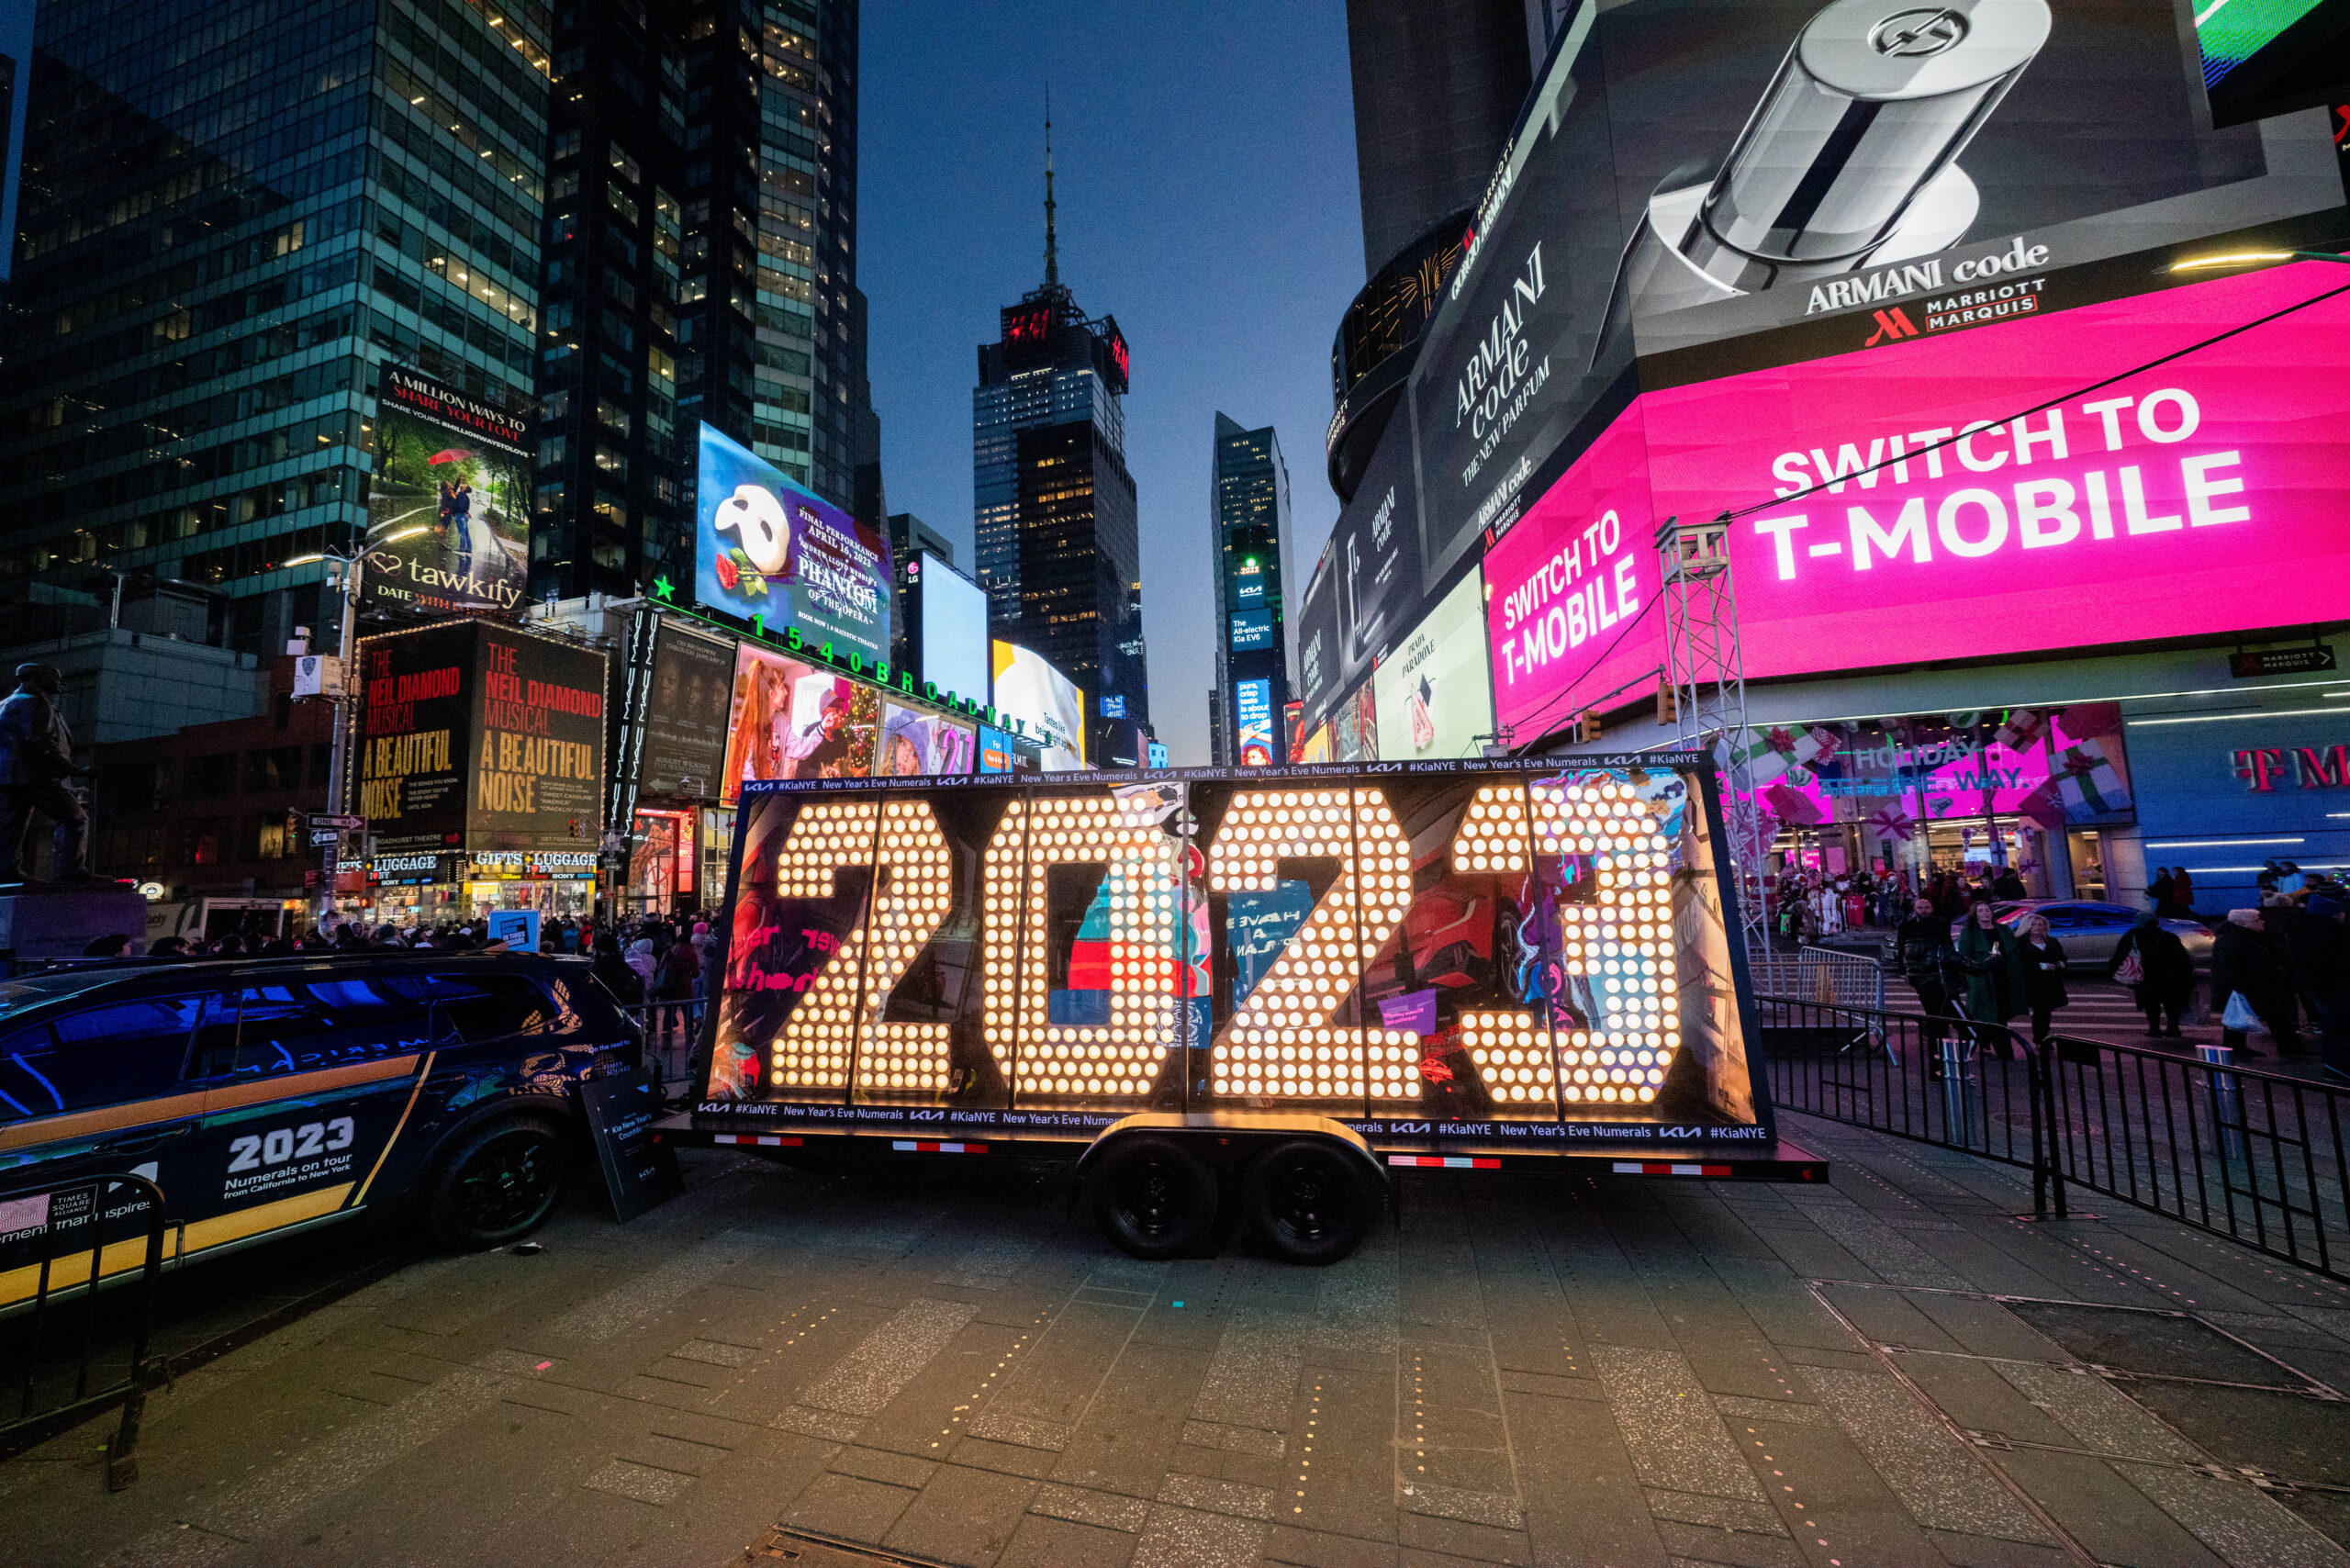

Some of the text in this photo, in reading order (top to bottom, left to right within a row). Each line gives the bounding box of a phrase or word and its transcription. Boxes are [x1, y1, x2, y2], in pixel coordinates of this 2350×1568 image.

[1477, 138, 1515, 220] MARRIOTT
[1451, 164, 1514, 300] GIORGIO ARMANI
[1805, 236, 2049, 316] ARMANI code
[1927, 278, 2046, 314] MARRIOTT
[1930, 297, 2034, 330] MARQUIS
[1456, 241, 1547, 429] ARMANI
[388, 370, 526, 433] A MILLION WAYS TO
[1472, 338, 1528, 440] code
[382, 398, 530, 459] SHARE YOURS #MILLIONWAYSTOLOVE
[394, 384, 522, 443] SHARE YOUR LOVE
[1462, 355, 1551, 487] THE NEW PARFUM
[1772, 387, 2201, 502] SWITCH TO
[1478, 455, 1532, 531] ARMANI code
[1371, 485, 1395, 543] ARMANI
[1494, 494, 1522, 530] MARRIOTT
[1495, 509, 1520, 540] MARQUIS
[1754, 450, 2251, 581] T-MOBILE
[799, 508, 878, 563] FINAL PERFORMANCE
[808, 524, 872, 567] APRIL 16, 2023
[1376, 519, 1393, 553] code
[828, 554, 849, 571] LLOYD
[1241, 566, 1260, 575] 2022
[1504, 510, 1620, 631] SWITCH TO
[408, 557, 522, 610] tawkify
[798, 555, 878, 614] PHANTOM
[908, 575, 919, 584] LG
[377, 585, 412, 601] DATE
[415, 593, 450, 610] WITH
[808, 588, 868, 625] OF THE OPERA
[798, 610, 814, 623] BOOK
[813, 618, 826, 630] NOW
[834, 626, 856, 641] MAJESTIC
[1233, 620, 1247, 628] The
[1234, 624, 1270, 635] All-electric
[1502, 553, 1639, 685] T-MOBILE
[1234, 633, 1260, 643] Kia EV6
[1304, 628, 1322, 675] ARMANI
[1407, 633, 1426, 656] PRADA
[372, 649, 394, 679] THE
[488, 643, 518, 675] THE
[1402, 639, 1436, 678] PARADOXE
[2262, 652, 2315, 662] MARRIOTT
[2264, 659, 2311, 668] MARQUIS
[368, 666, 461, 707] NEIL DIAMOND
[486, 670, 602, 718] NEIL DIAMOND
[1240, 682, 1258, 691] pure,
[1240, 689, 1258, 699] crisp
[367, 703, 417, 735] MUSICAL
[485, 699, 550, 736] MUSICAL
[1043, 711, 1058, 729] Tastes
[1248, 703, 1269, 712] about
[1249, 711, 1268, 721] drop
[363, 729, 453, 779] A BEAUTIFUL
[480, 729, 596, 780] A BEAUTIFUL
[992, 740, 1001, 750] For
[1855, 741, 1979, 769] HOLIDAY
[779, 753, 1699, 790] #KiaNYE New Year's Eve Numerals #KiaNYE New Year's Eve Numerals #KiaNYE
[1953, 767, 2029, 791] WAY.
[360, 778, 404, 821] NOISE
[478, 770, 537, 813] NOISE
[414, 834, 442, 844] THEATRE
[373, 856, 437, 872] LUGGAGE
[476, 853, 523, 866] GIFTS
[534, 854, 597, 866] LUGGAGE
[509, 931, 525, 939] TIMES
[769, 782, 1682, 1105] 2023
[588, 1039, 631, 1055] On the road to
[603, 1061, 624, 1070] TIMES
[607, 1065, 632, 1076] SQUARE
[611, 1124, 623, 1135] Kia
[622, 1118, 635, 1129] New
[735, 1104, 903, 1120] #KiaNYE New Year's Eve Numerals
[227, 1116, 355, 1173] 2023
[1439, 1124, 1767, 1140] #KiaNYE New Year's Eve Numerals #KiaNYE
[223, 1163, 351, 1200] from California to New York
[225, 1152, 352, 1191] Numerals on tour
[52, 1198, 91, 1212] SQUARE
[54, 1205, 88, 1216] ALLIANCE
[57, 1193, 89, 1204] TIMES
